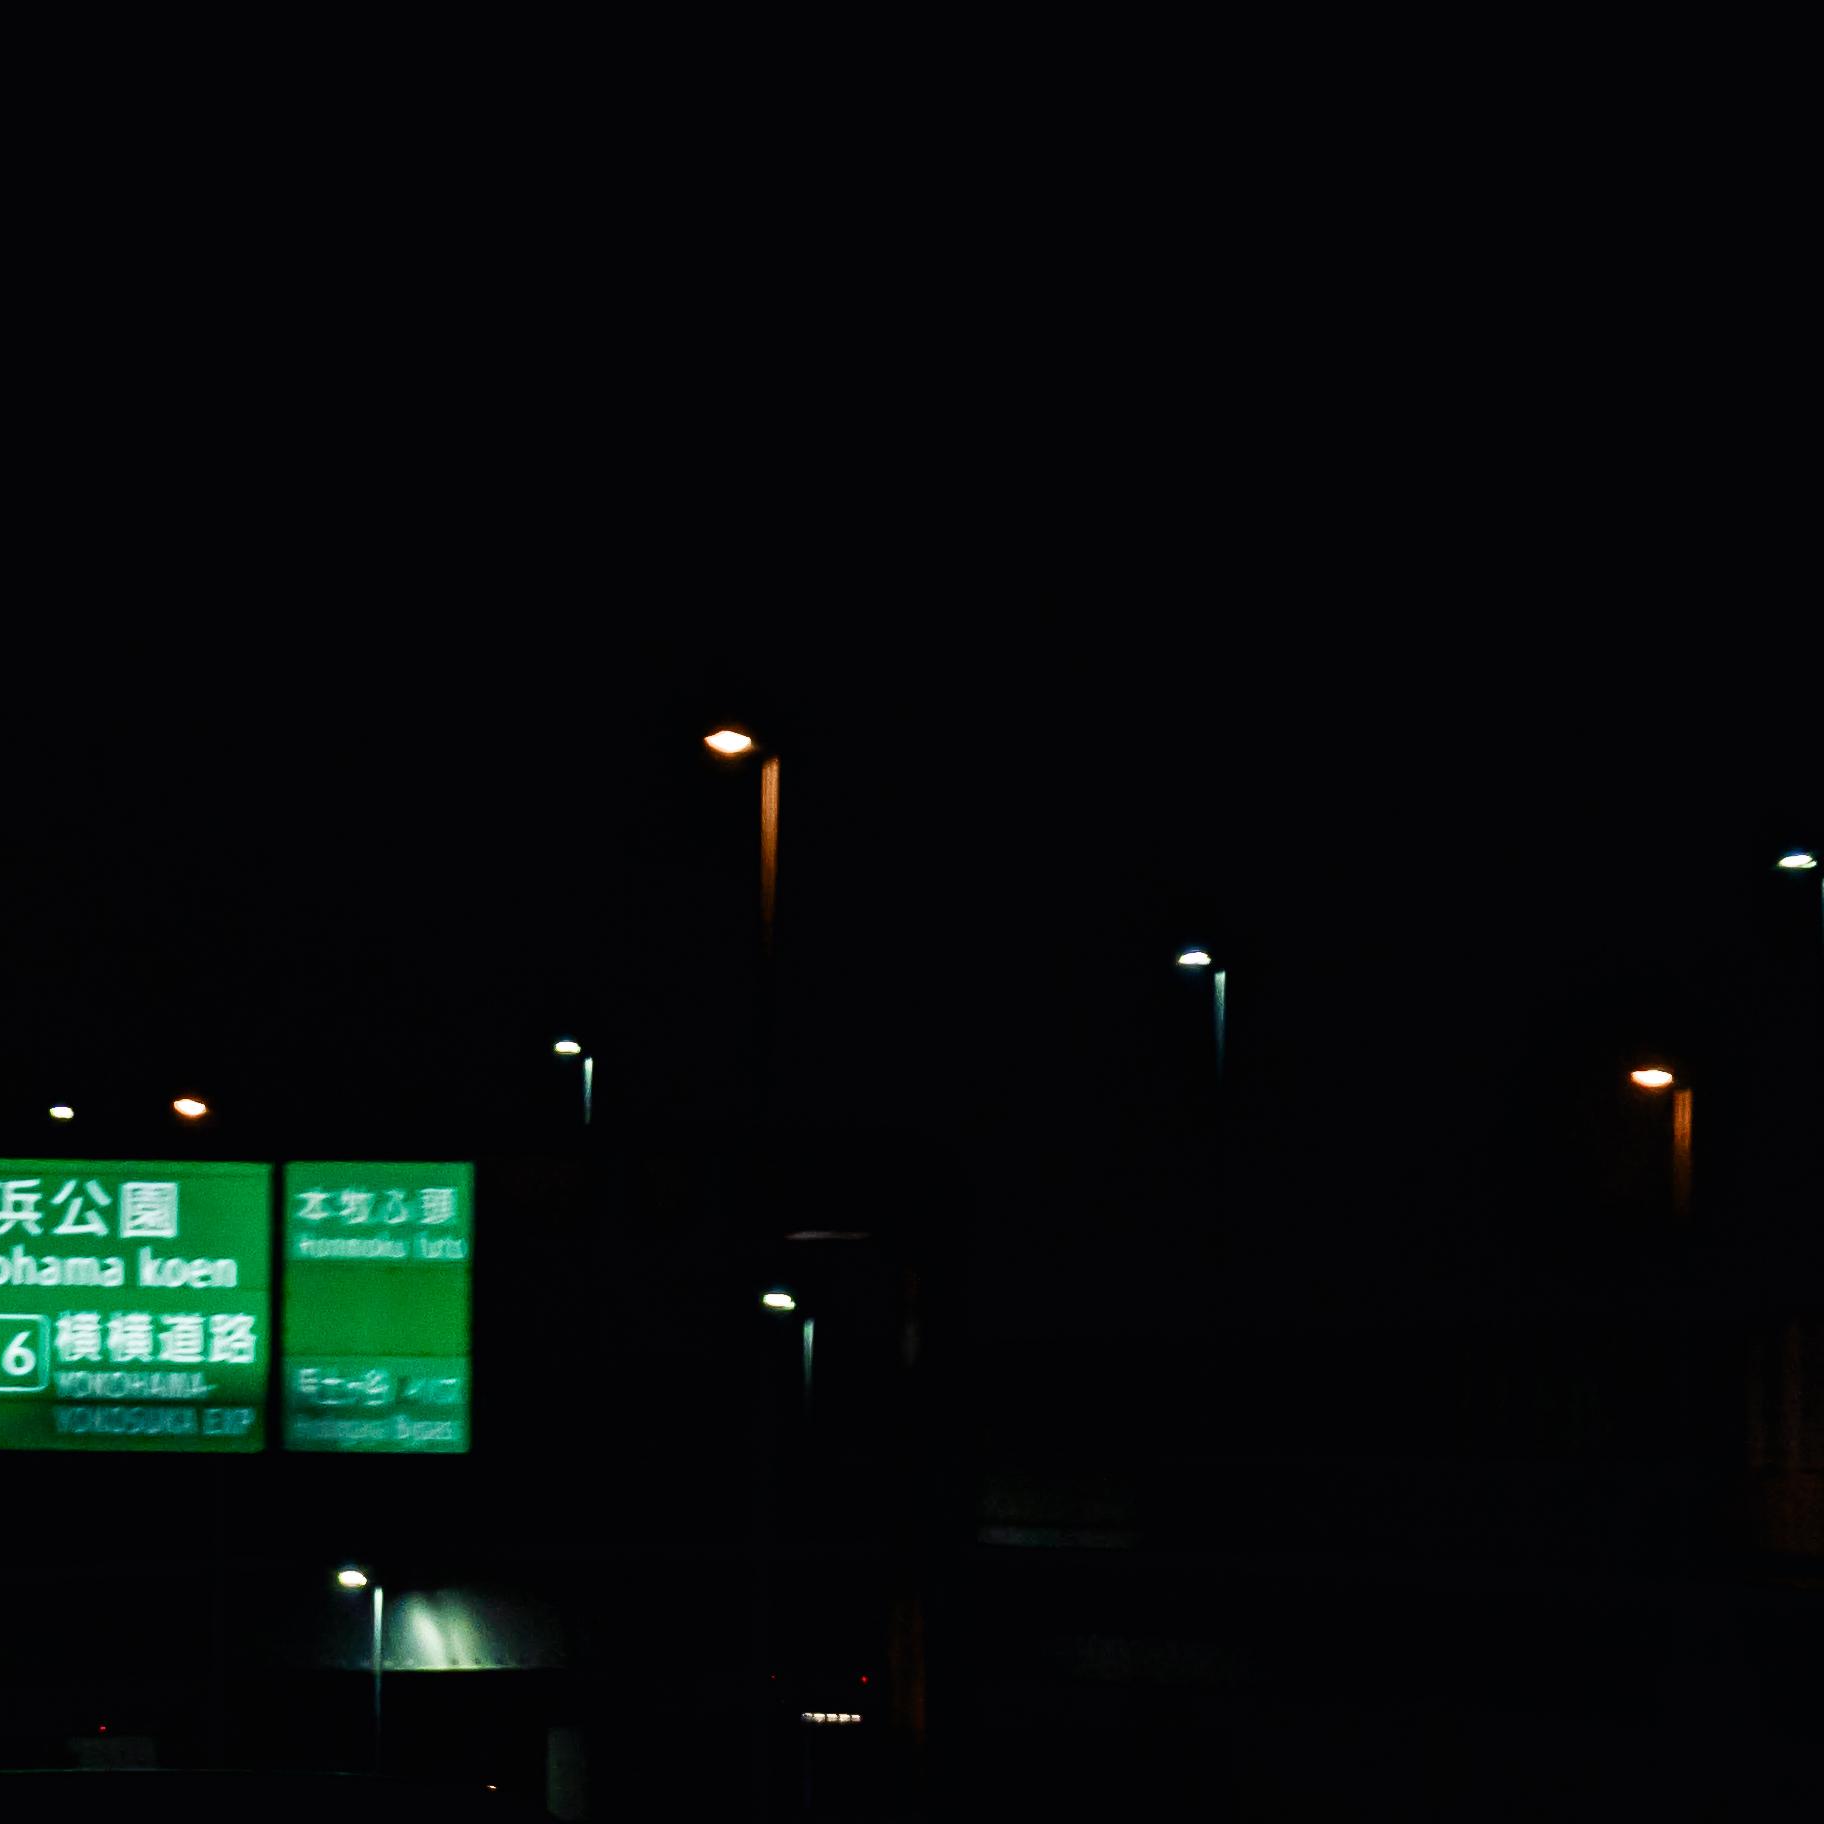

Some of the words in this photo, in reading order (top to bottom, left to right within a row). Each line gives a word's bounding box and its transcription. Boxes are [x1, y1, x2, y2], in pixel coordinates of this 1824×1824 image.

[139, 1246, 237, 1288] koen
[54, 1312, 256, 1364] 横横道路
